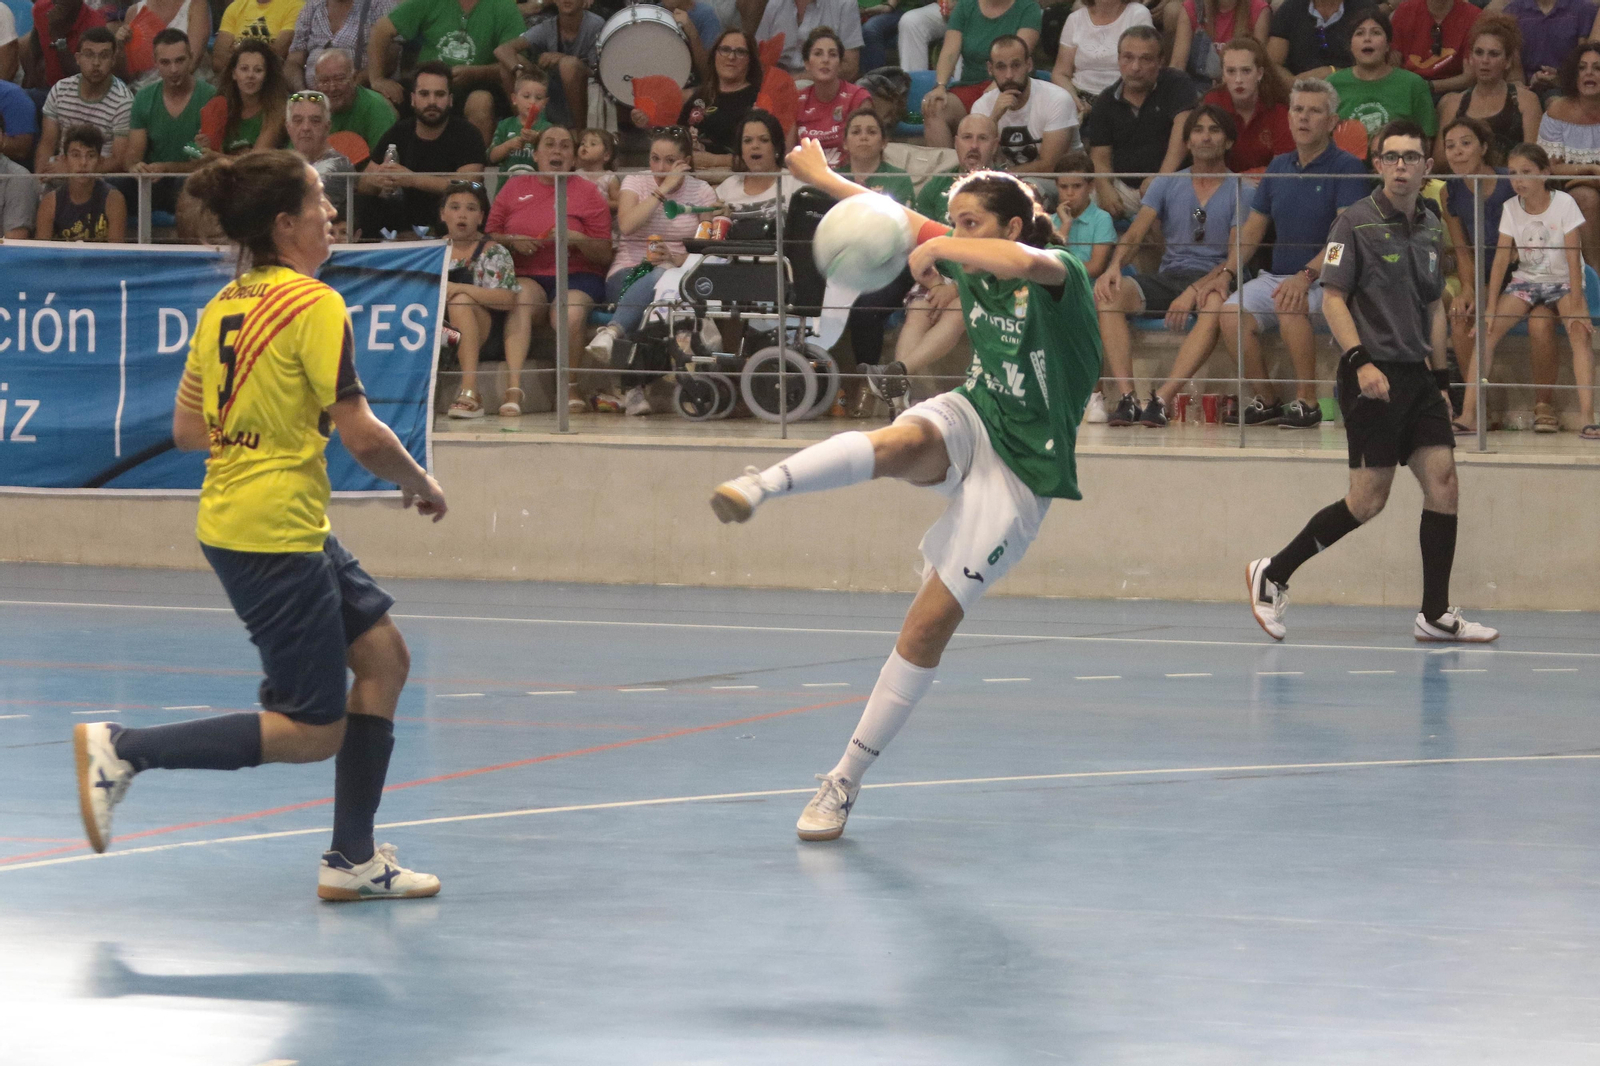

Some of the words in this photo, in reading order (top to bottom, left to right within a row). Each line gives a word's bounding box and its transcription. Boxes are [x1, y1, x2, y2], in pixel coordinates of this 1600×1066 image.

[218, 313, 246, 410] 5
[987, 545, 1005, 566] 6
[852, 738, 880, 757] Joma
